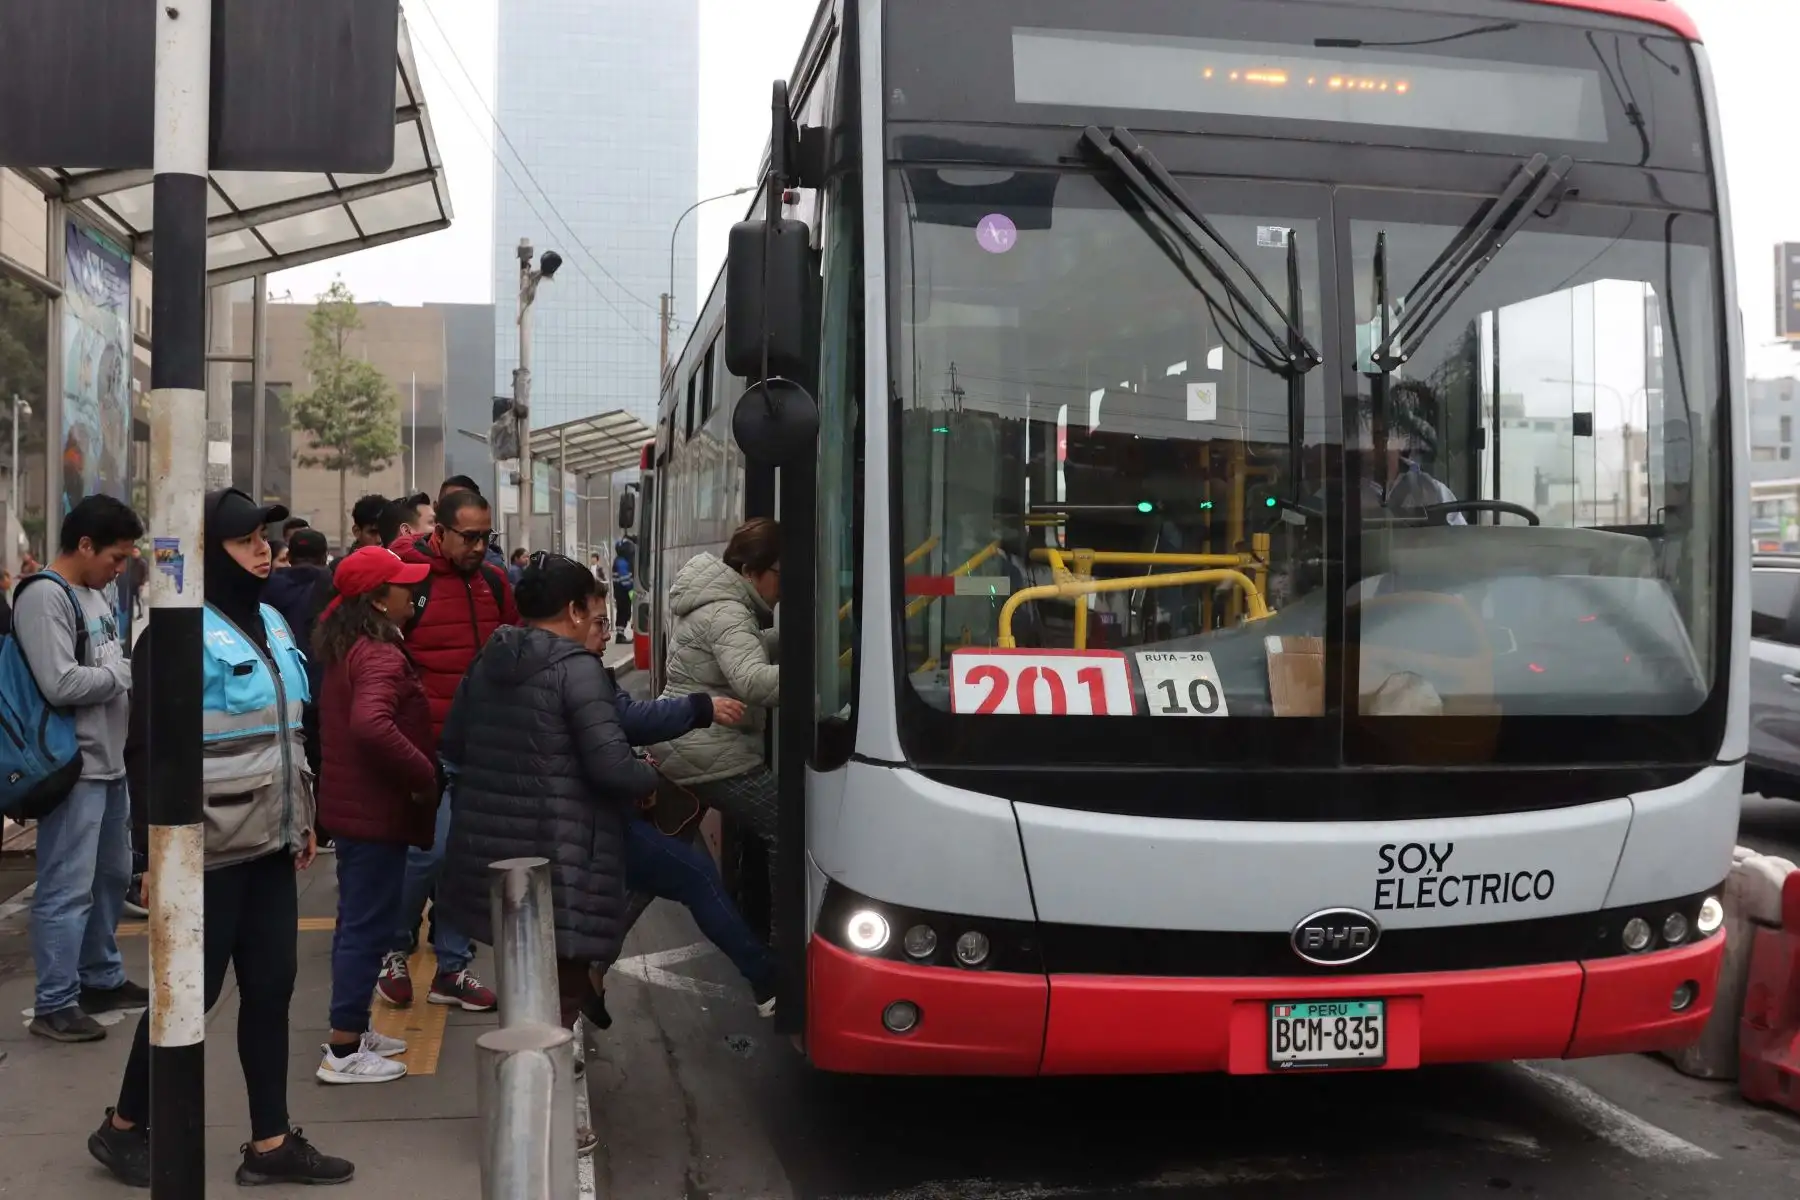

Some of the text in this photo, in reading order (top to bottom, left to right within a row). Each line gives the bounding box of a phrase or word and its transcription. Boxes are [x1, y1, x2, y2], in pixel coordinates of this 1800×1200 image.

[964, 664, 1108, 715] 201
[1157, 678, 1220, 714] 10
[1377, 843, 1454, 875] SOY
[1374, 868, 1555, 911] ELÉCTRICO
[1303, 925, 1371, 949] BYD
[1308, 1004, 1348, 1016] PERU
[1276, 1016, 1379, 1053] BCM-835
